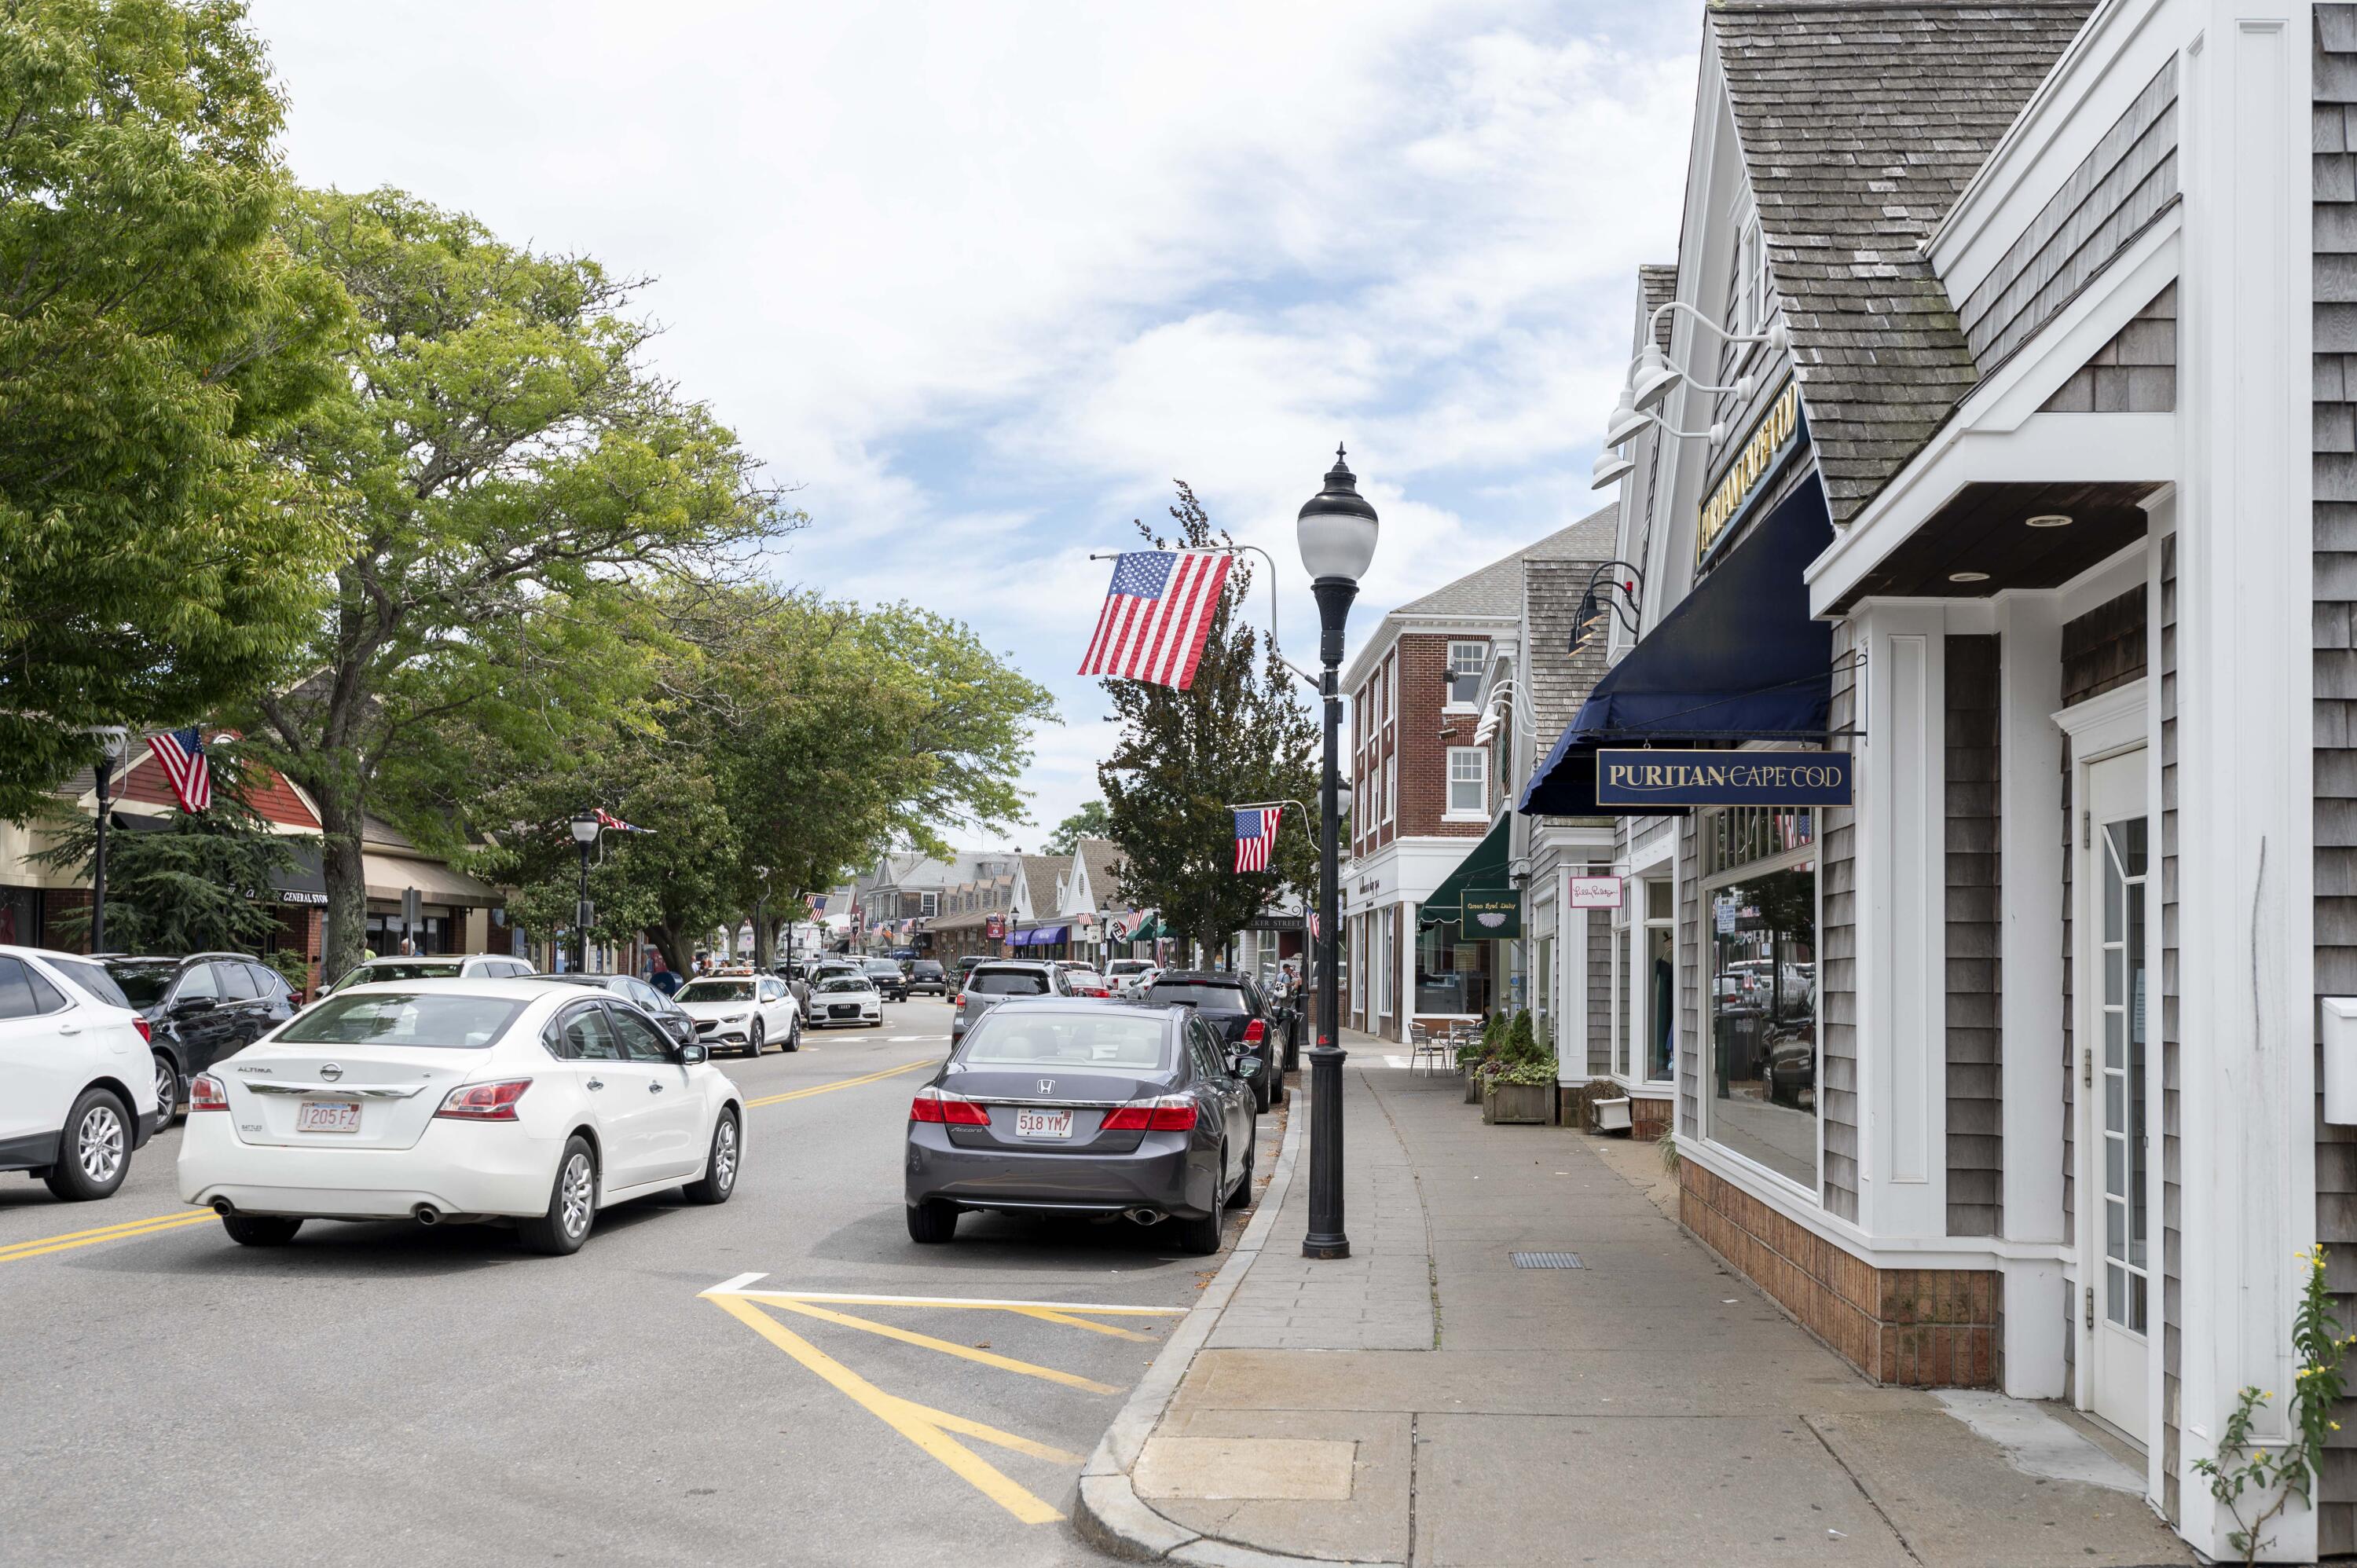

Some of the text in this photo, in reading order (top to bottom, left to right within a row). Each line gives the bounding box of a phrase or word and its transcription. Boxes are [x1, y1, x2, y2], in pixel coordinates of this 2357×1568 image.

[1701, 381, 1798, 553] PURITAN CAPE COD
[1609, 765, 1842, 788] PURITAN CAPE COD
[284, 892, 312, 903] GENERAL
[1573, 885, 1618, 899] Lilly Pulitzer
[1112, 922, 1127, 941] PEN
[1020, 1116, 1070, 1131] 518 YM7
